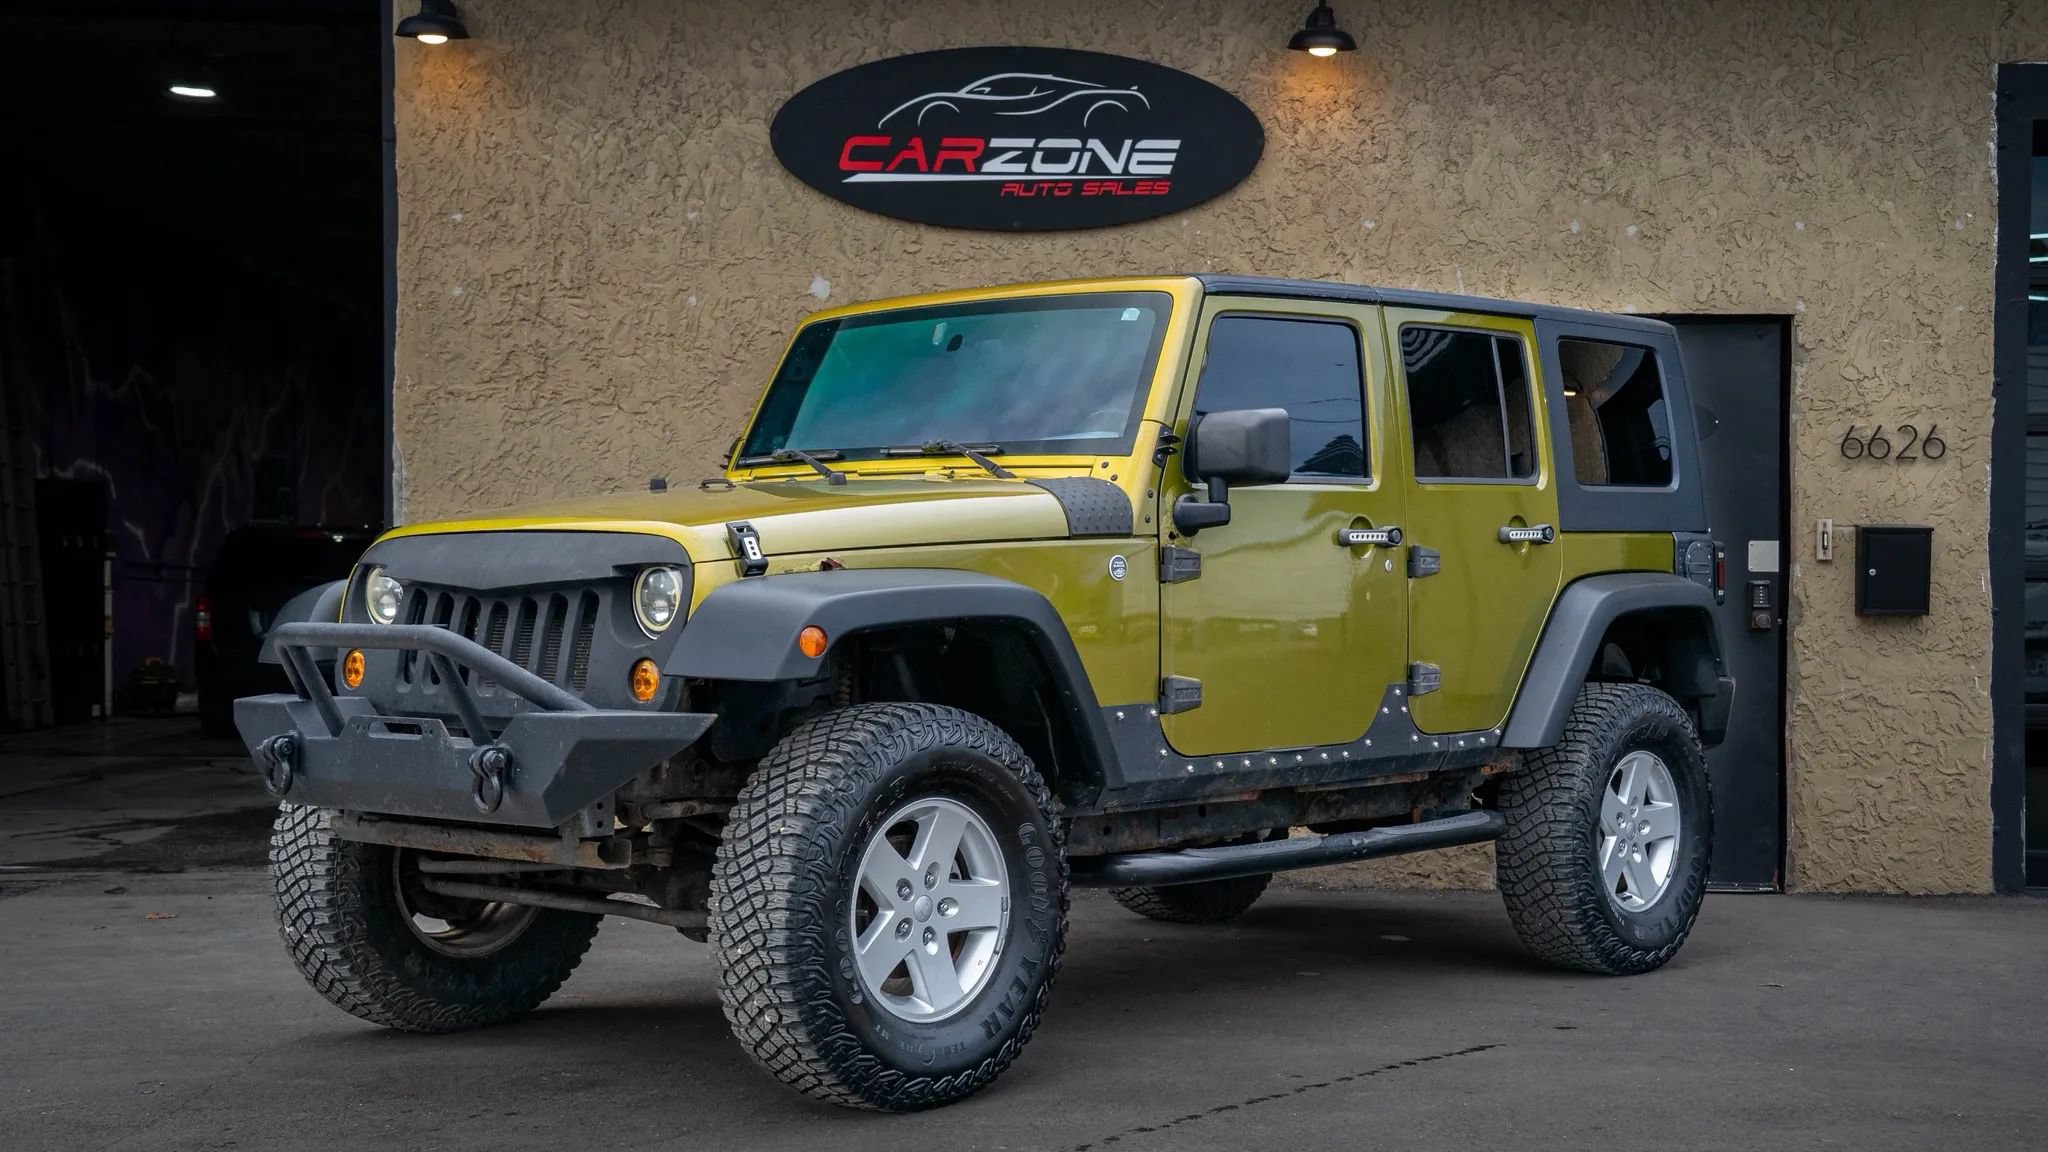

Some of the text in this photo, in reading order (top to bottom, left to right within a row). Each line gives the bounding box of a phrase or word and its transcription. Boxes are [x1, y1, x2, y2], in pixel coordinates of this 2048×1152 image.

[838, 135, 1182, 175] CARZONE
[1000, 180, 1172, 197] AUTO SALES
[1840, 424, 1947, 461] 6626
